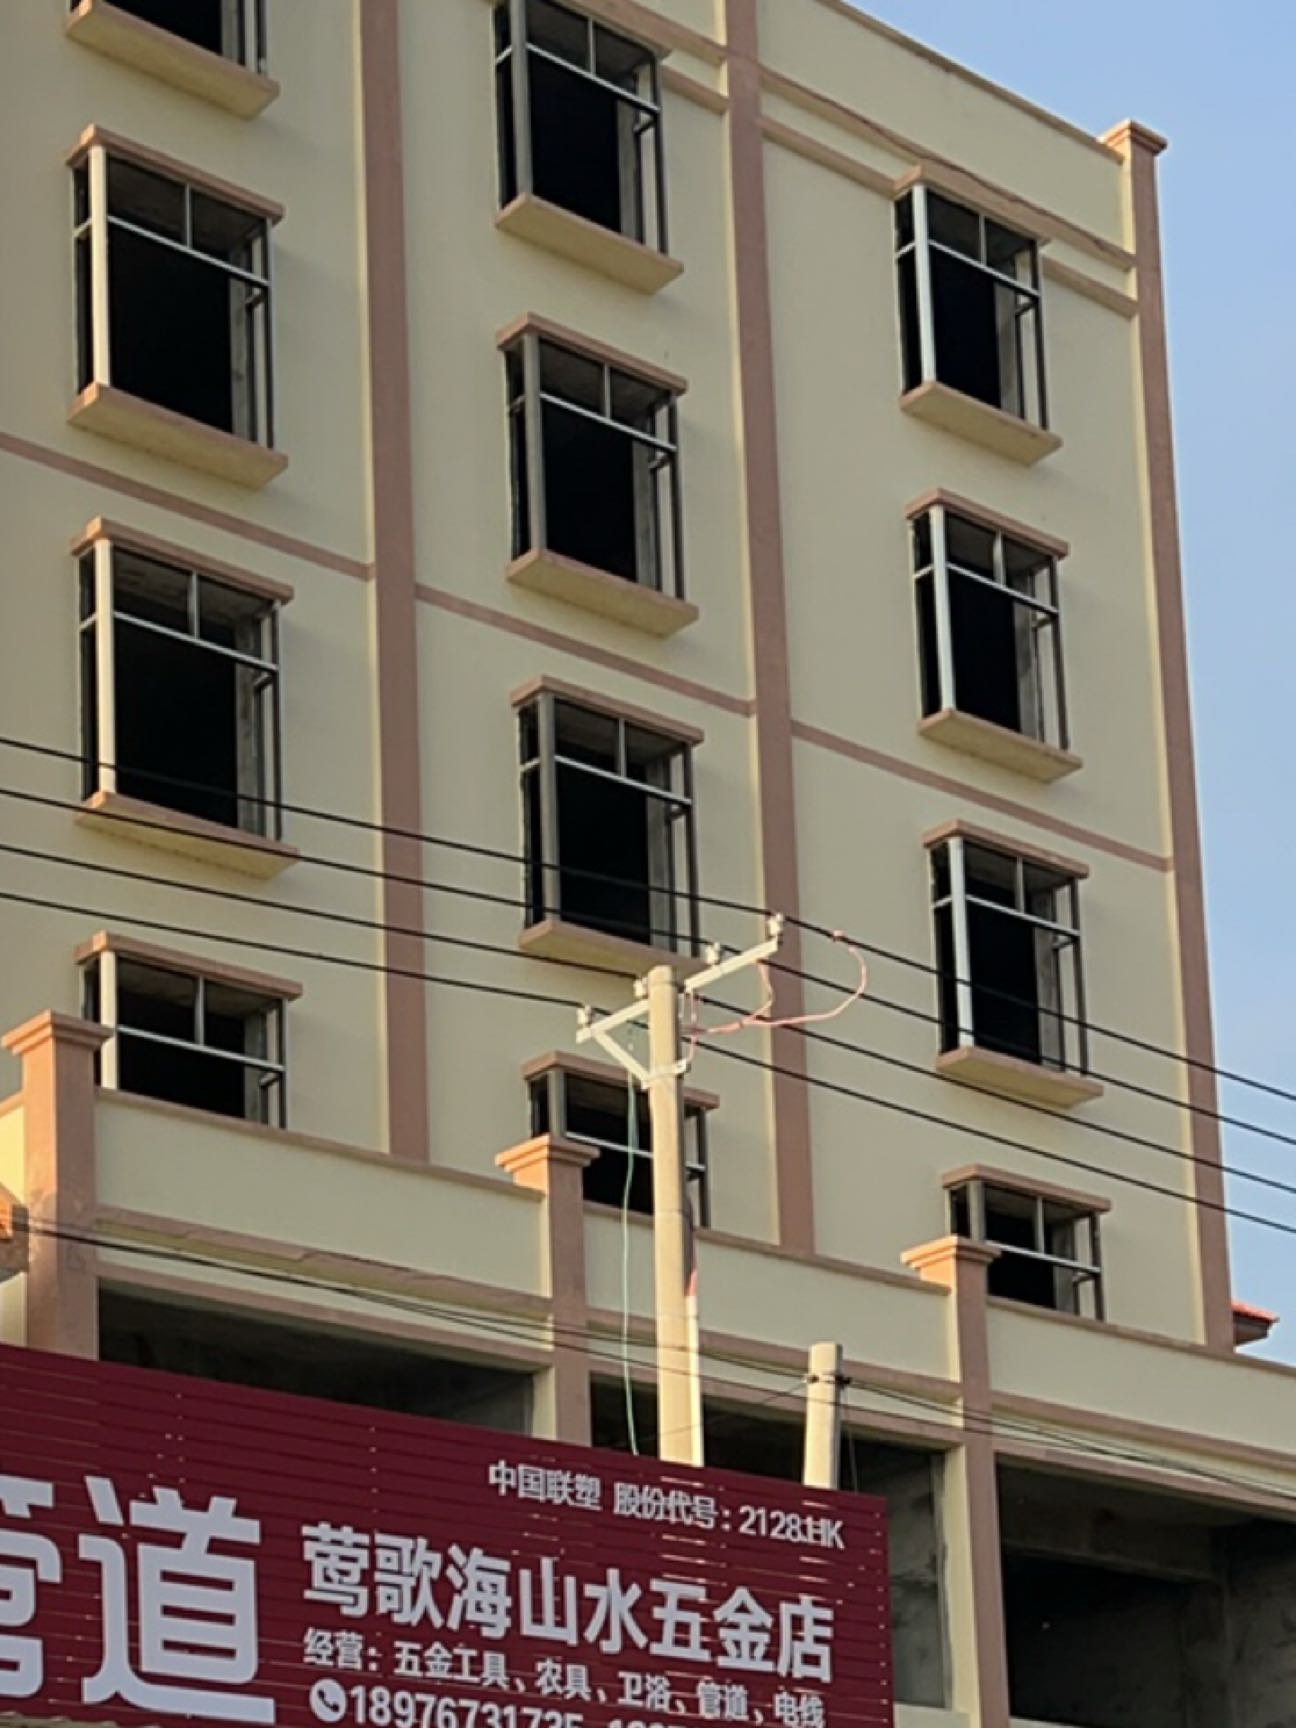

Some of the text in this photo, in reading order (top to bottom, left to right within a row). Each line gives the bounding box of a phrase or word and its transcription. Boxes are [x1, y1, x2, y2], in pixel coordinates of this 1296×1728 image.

[488, 1459, 602, 1511] 中国联塑
[301, 1521, 834, 1684] 莺歌海山水五金店
